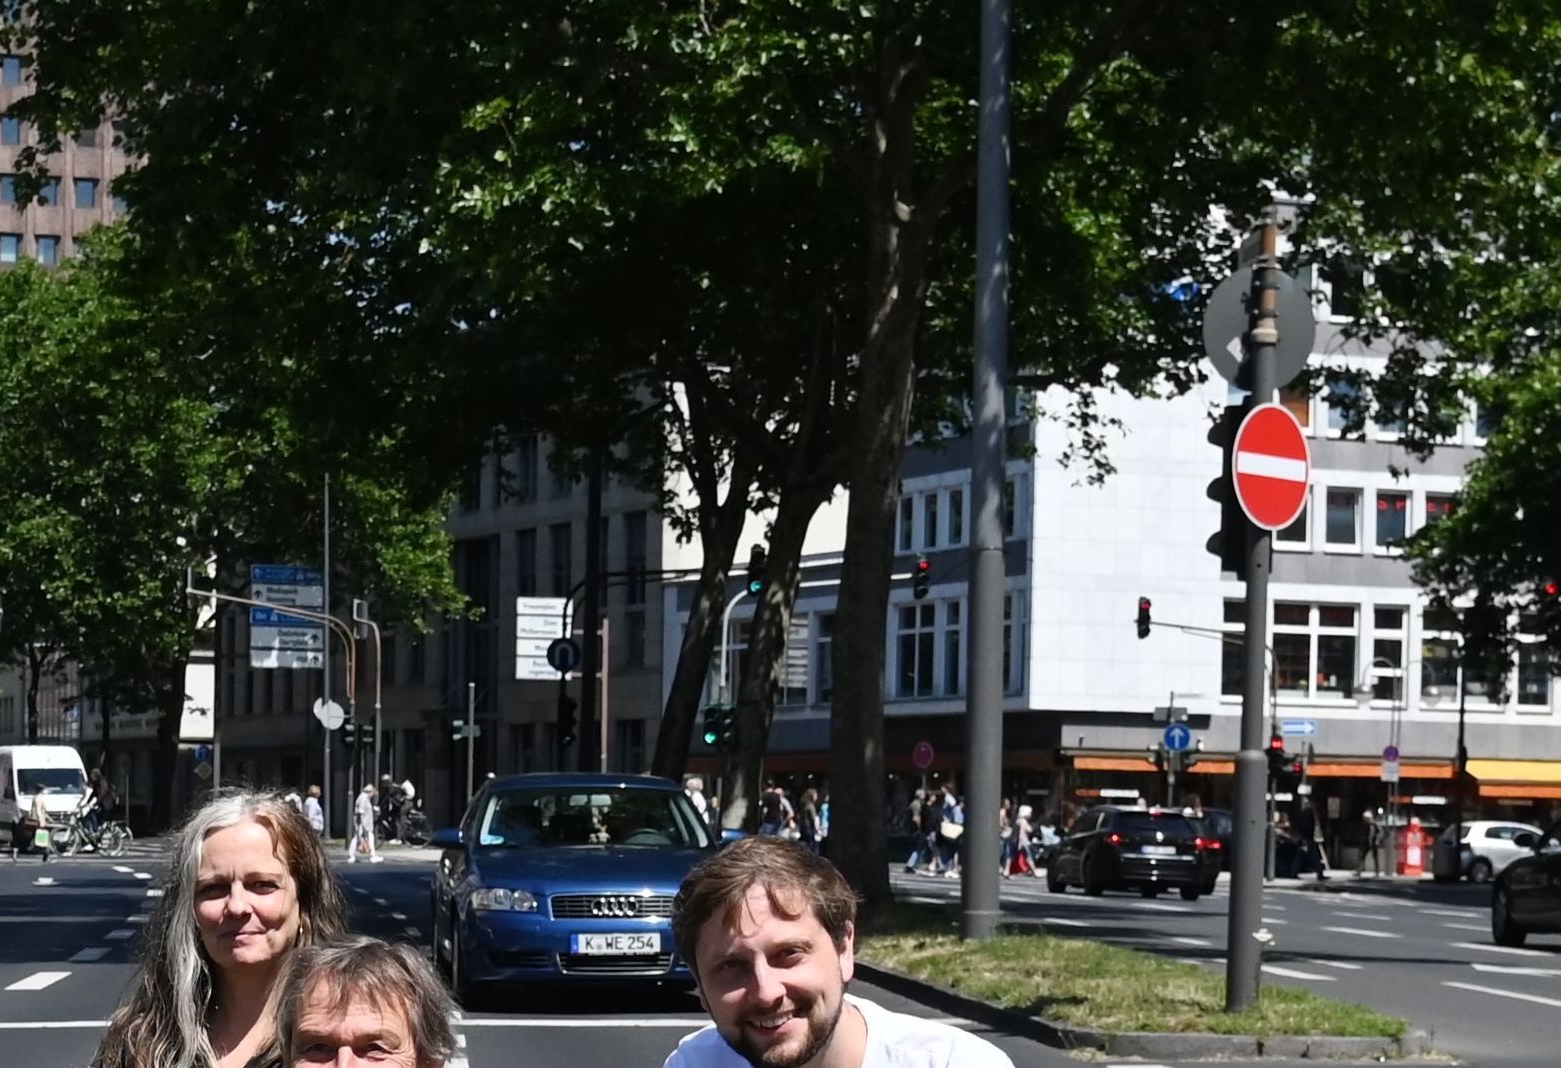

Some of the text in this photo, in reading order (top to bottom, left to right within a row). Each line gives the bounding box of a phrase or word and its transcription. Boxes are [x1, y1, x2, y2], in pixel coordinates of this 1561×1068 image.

[585, 936, 654, 950] K WE 254
